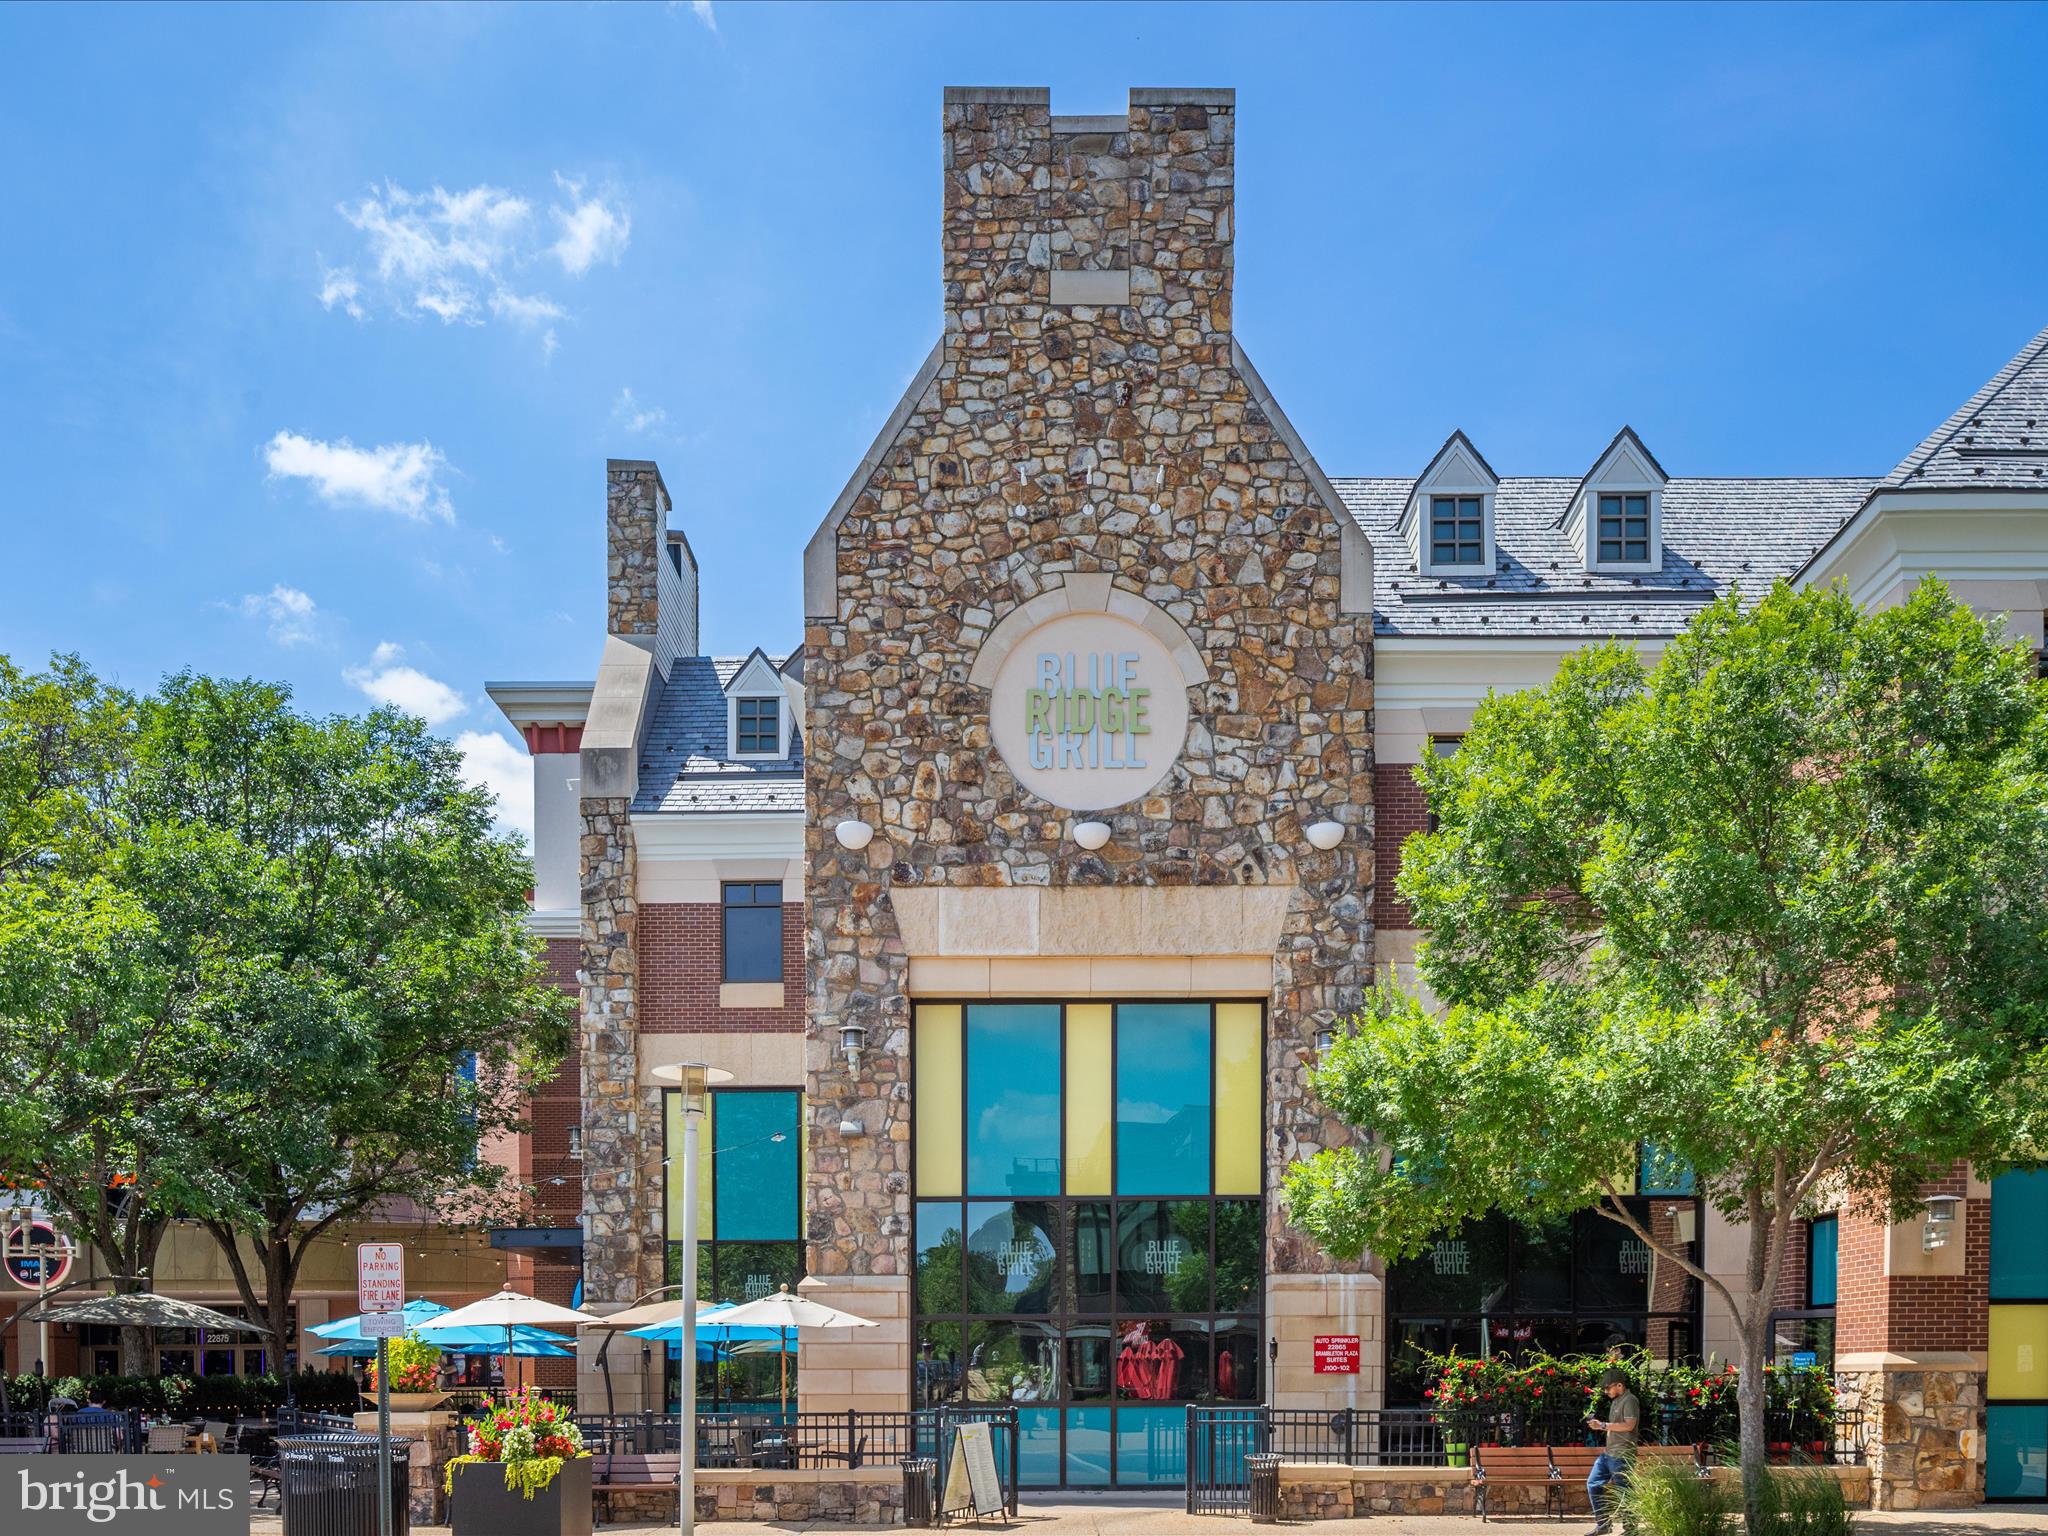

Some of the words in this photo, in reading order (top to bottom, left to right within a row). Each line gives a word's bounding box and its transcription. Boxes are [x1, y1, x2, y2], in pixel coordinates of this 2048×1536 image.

[1037, 653, 1139, 699] BLUE
[1026, 688, 1152, 734] RIDGE
[1029, 724, 1148, 770] GRILL
[1000, 1241, 1031, 1253] BLUE
[1148, 1240, 1179, 1252] BLUE
[1436, 1240, 1467, 1253] BLUE
[375, 1252, 386, 1260] NO
[997, 1252, 1034, 1265] RIDGE
[1145, 1251, 1182, 1264] RIDGE
[1434, 1251, 1471, 1264] RIDGE
[1619, 1250, 1648, 1263] RIDG
[363, 1262, 399, 1271] PARKING
[1146, 1261, 1181, 1275] GRILL
[1435, 1262, 1470, 1275] GRILL
[1620, 1261, 1648, 1274] GRIL
[362, 1280, 400, 1288] STANDING
[747, 1274, 771, 1285] BLUE
[744, 1282, 773, 1292] RIDGE
[363, 1290, 379, 1301] FIRE
[381, 1290, 400, 1301] LANE
[207, 1334, 230, 1342] 22875
[328, 1455, 345, 1463] Trash
